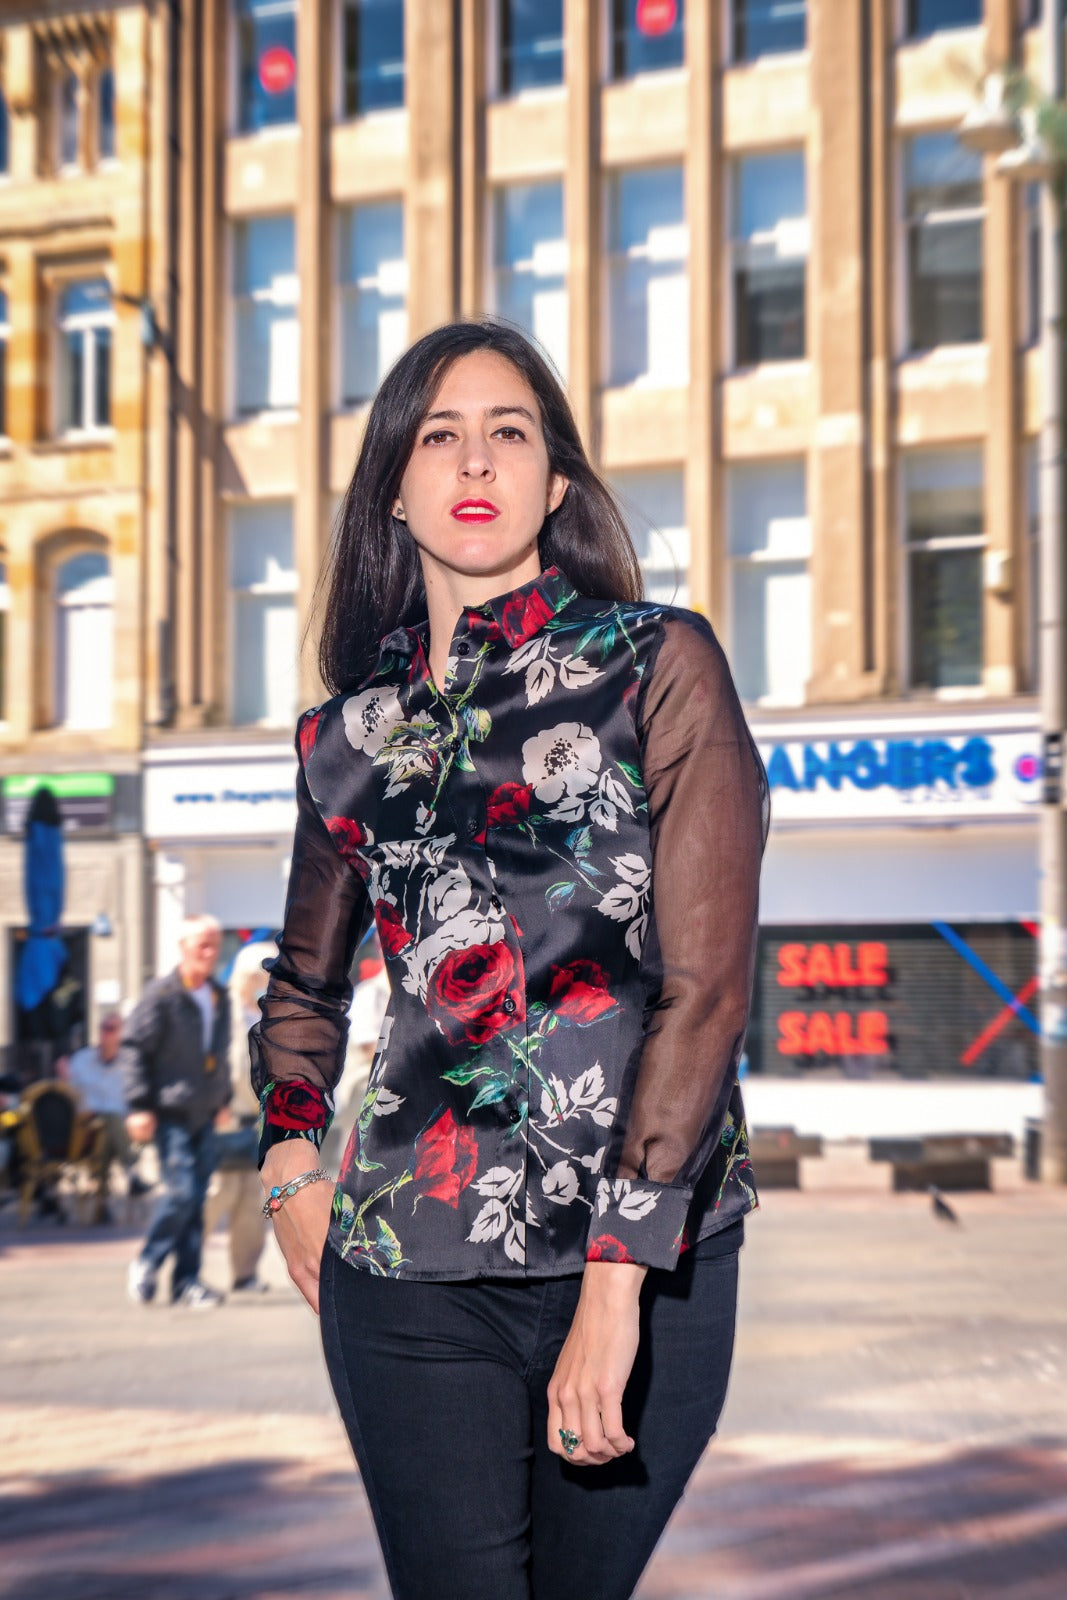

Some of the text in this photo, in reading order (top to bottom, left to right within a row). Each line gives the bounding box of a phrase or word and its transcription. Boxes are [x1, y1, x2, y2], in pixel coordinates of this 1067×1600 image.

[767, 737, 996, 791] ANGERS
[777, 942, 888, 987] SALE
[777, 1011, 888, 1056] SALE
